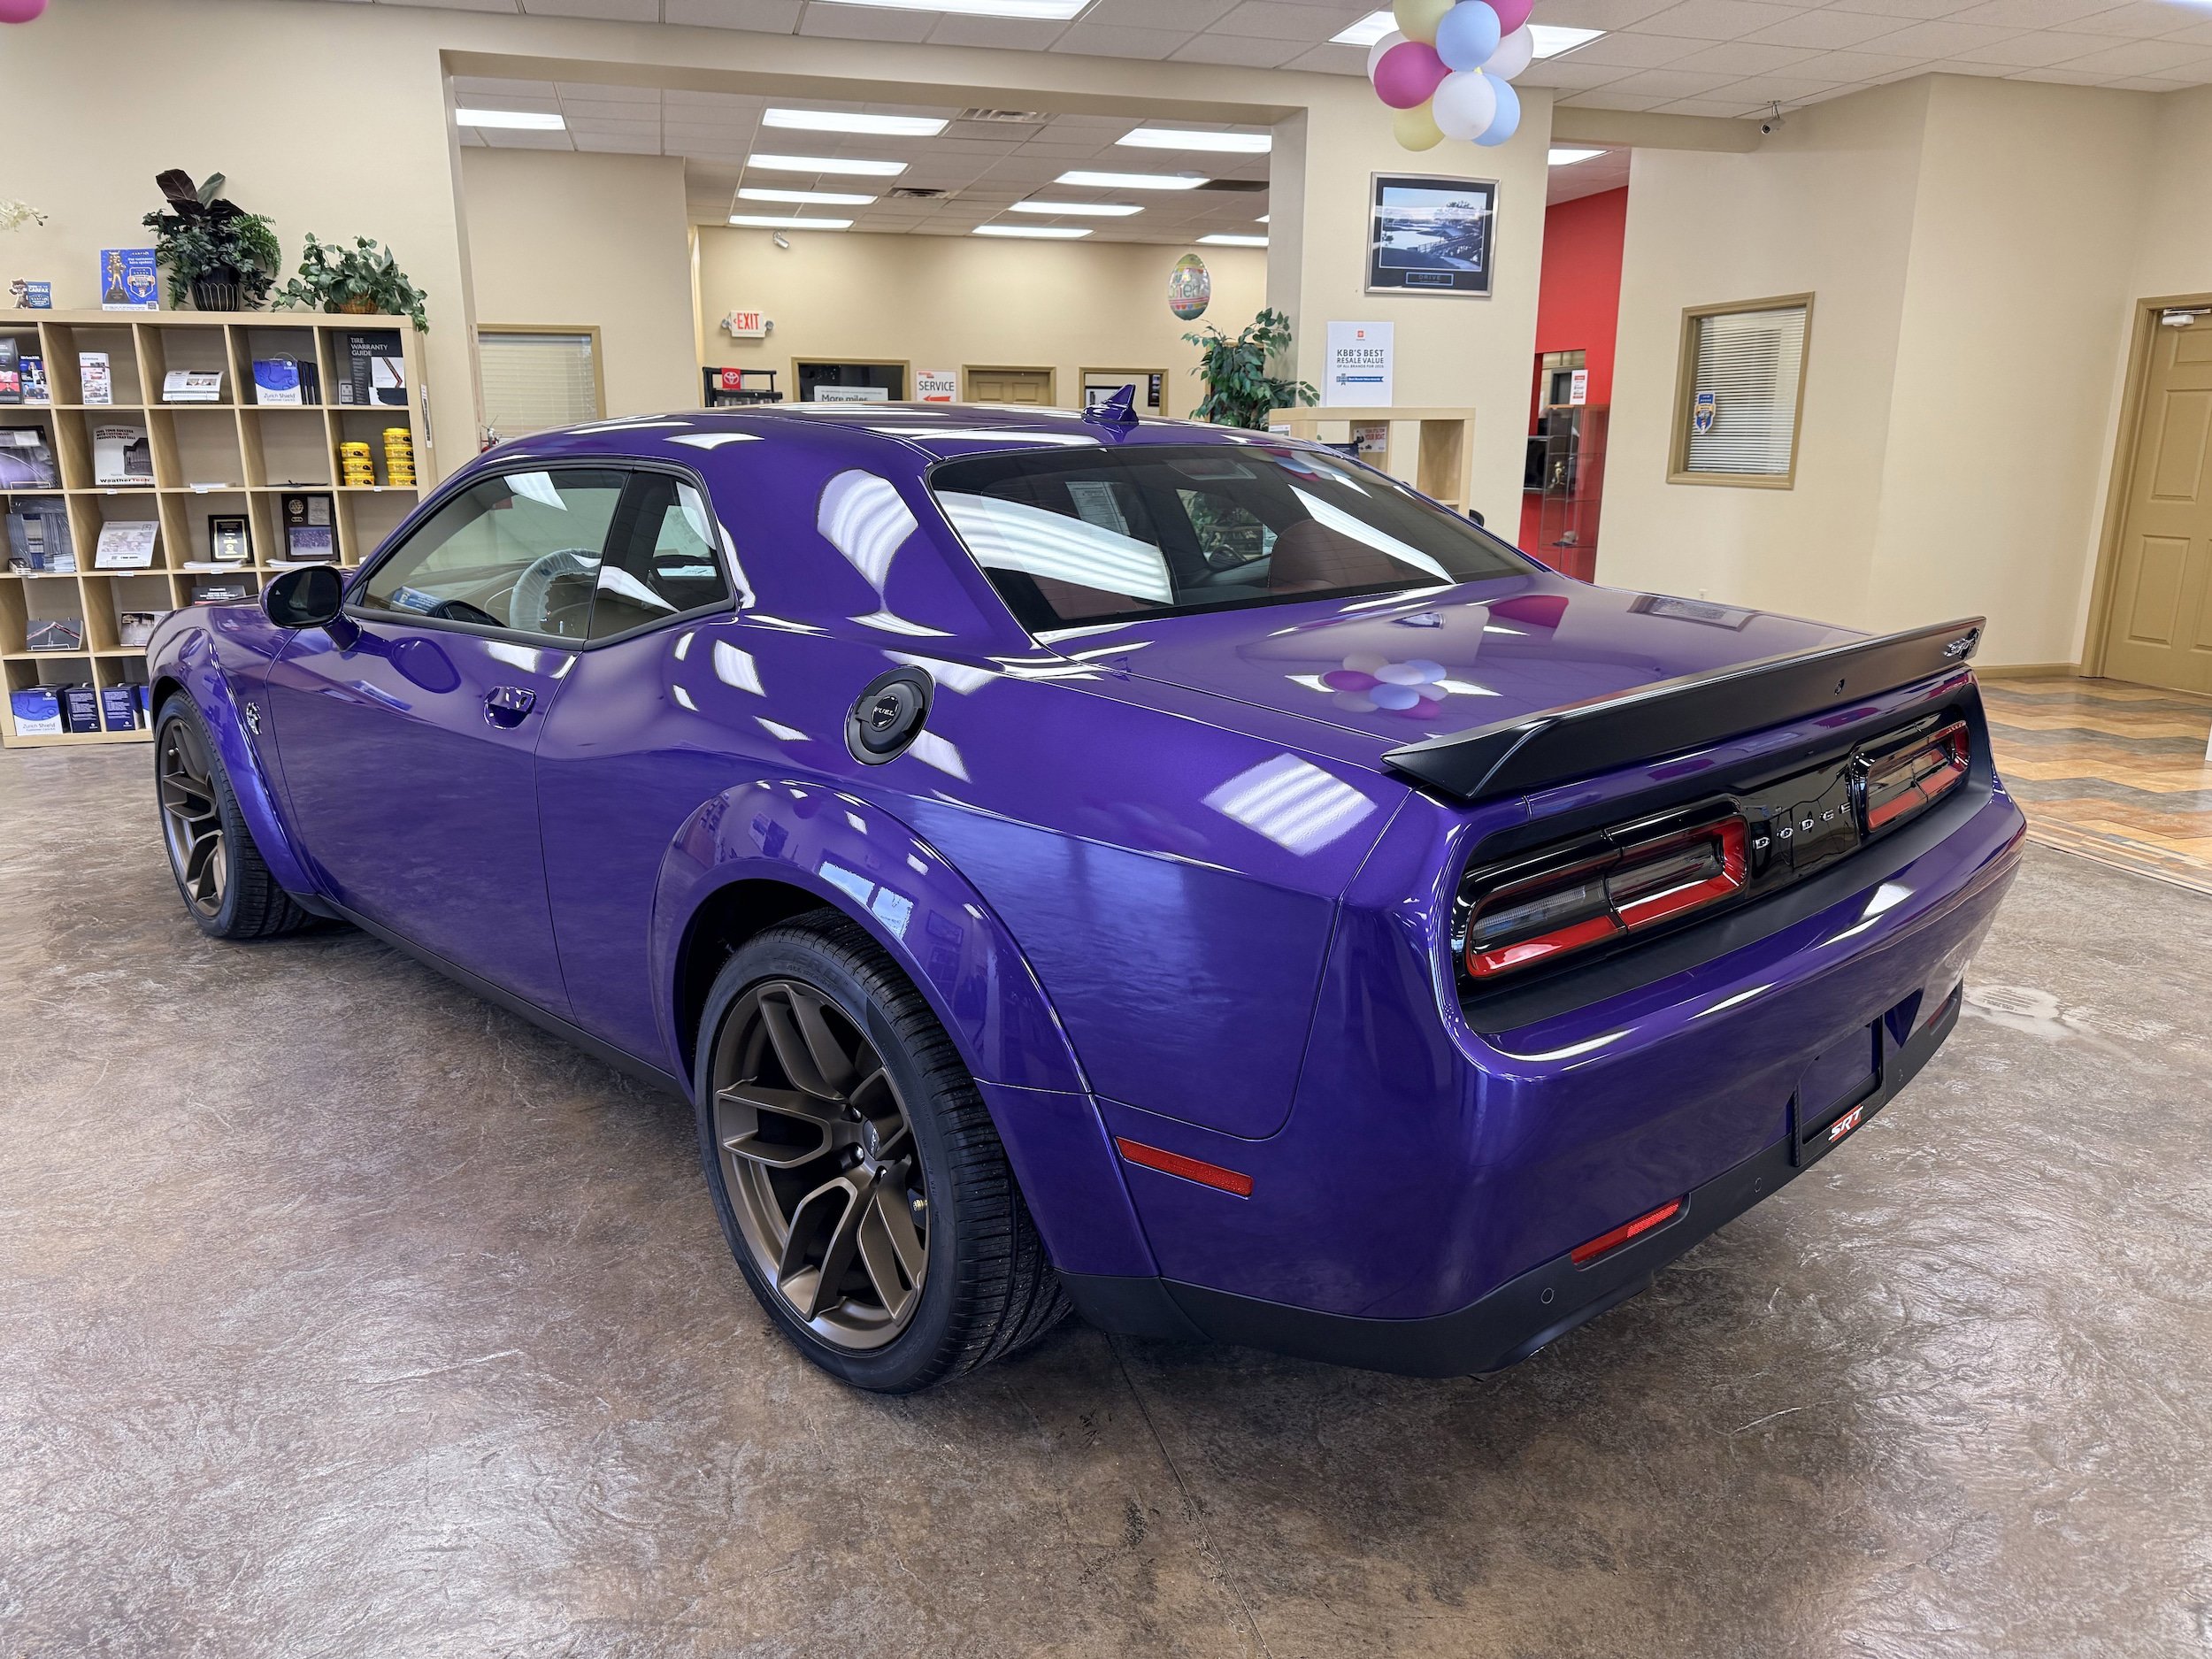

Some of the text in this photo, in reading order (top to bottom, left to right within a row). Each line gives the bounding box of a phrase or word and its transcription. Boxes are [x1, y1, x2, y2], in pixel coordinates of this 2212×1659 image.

[737, 313, 759, 329] EXIT
[918, 380, 954, 391] SERVICE
[1753, 802, 1851, 849] DODGE
[1828, 1106, 1863, 1141] SRT
